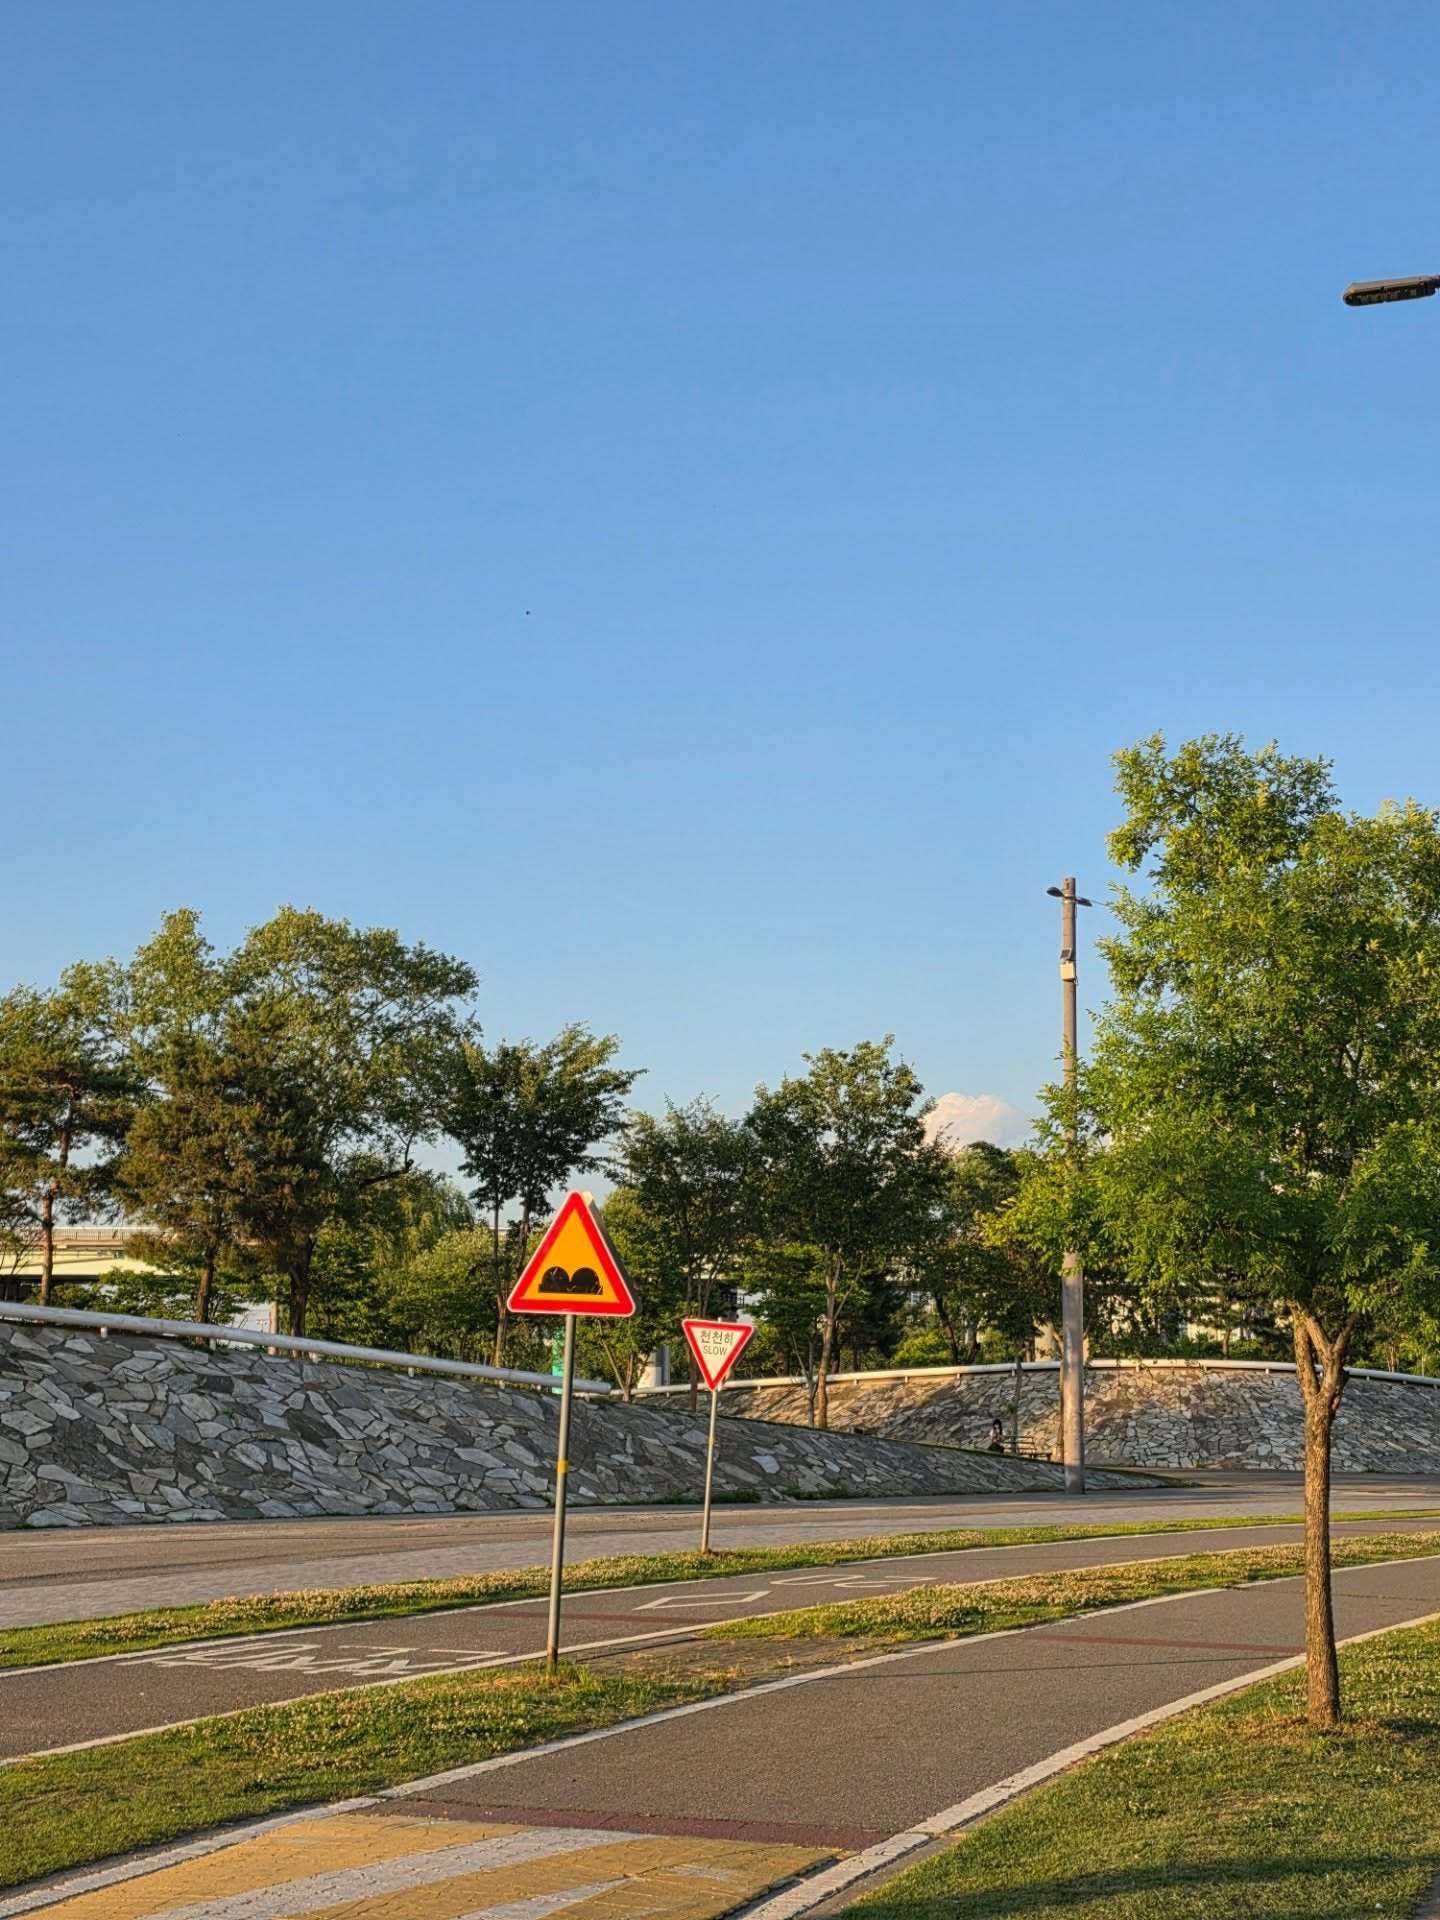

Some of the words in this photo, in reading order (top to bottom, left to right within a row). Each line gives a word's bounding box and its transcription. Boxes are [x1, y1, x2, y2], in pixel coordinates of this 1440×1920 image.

[701, 1330, 734, 1345] 천천히
[703, 1345, 727, 1356] SLOW
[769, 1574, 939, 1588] 20
